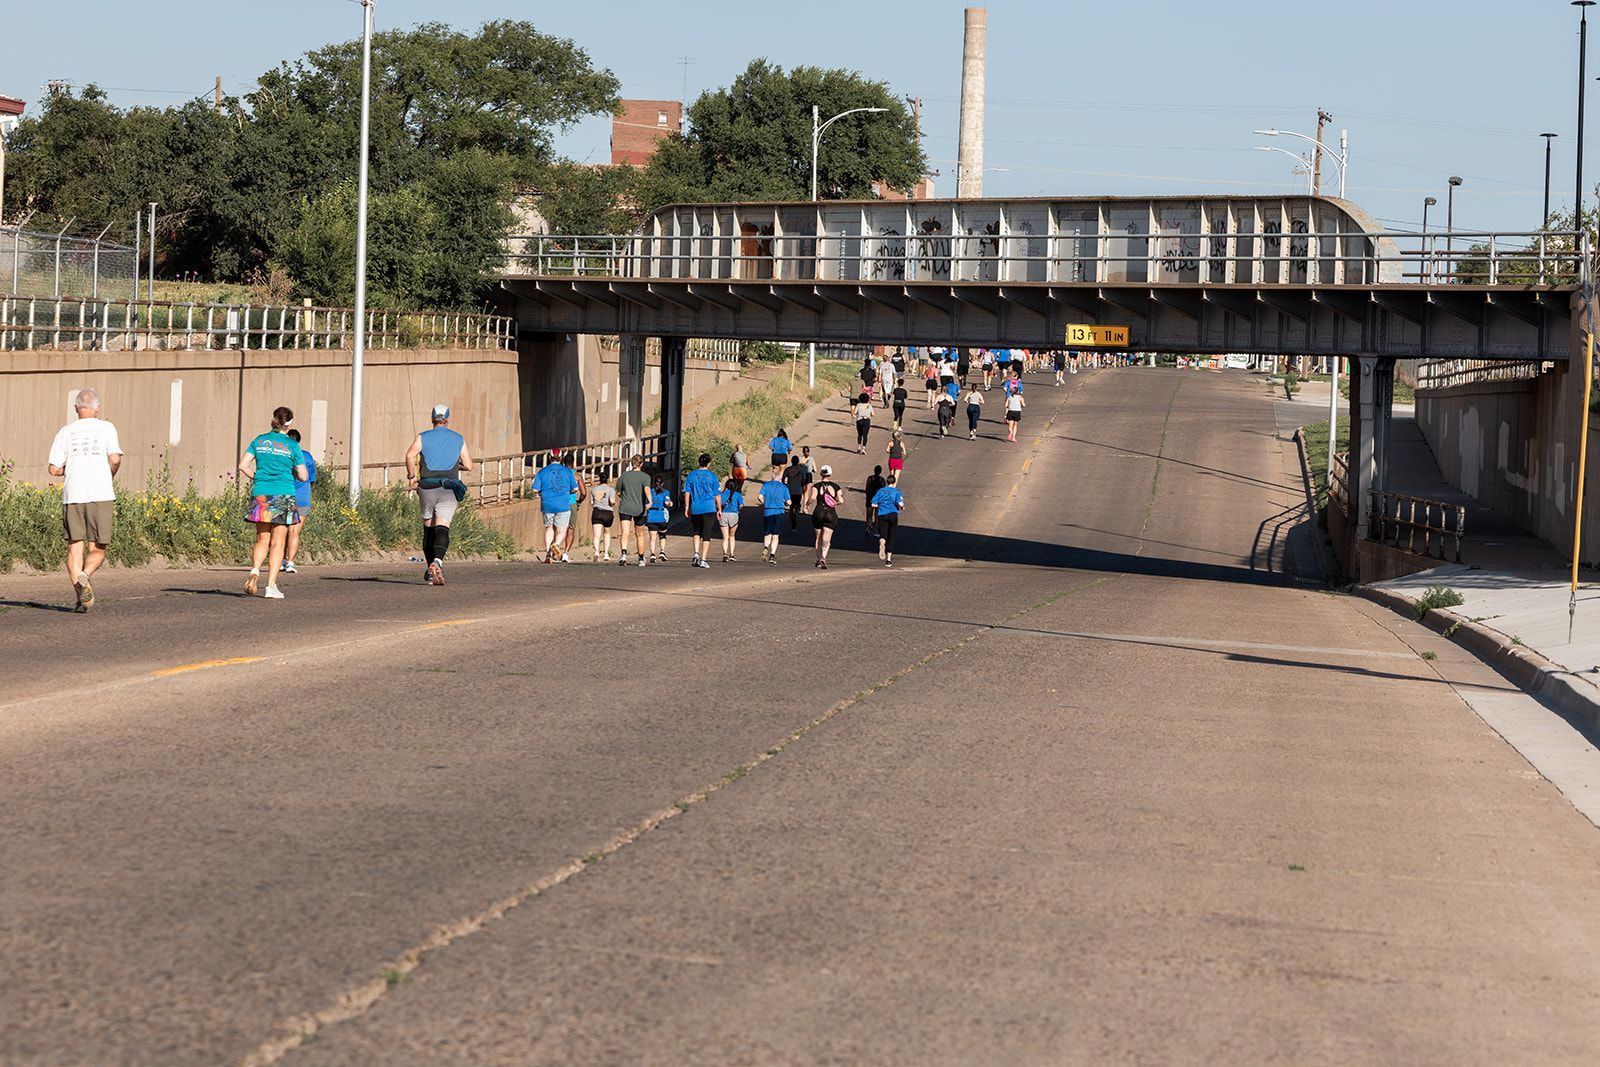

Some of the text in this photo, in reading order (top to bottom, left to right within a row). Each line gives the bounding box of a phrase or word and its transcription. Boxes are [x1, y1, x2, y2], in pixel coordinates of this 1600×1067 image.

[1072, 329, 1124, 342] 13 FT 11 IN
